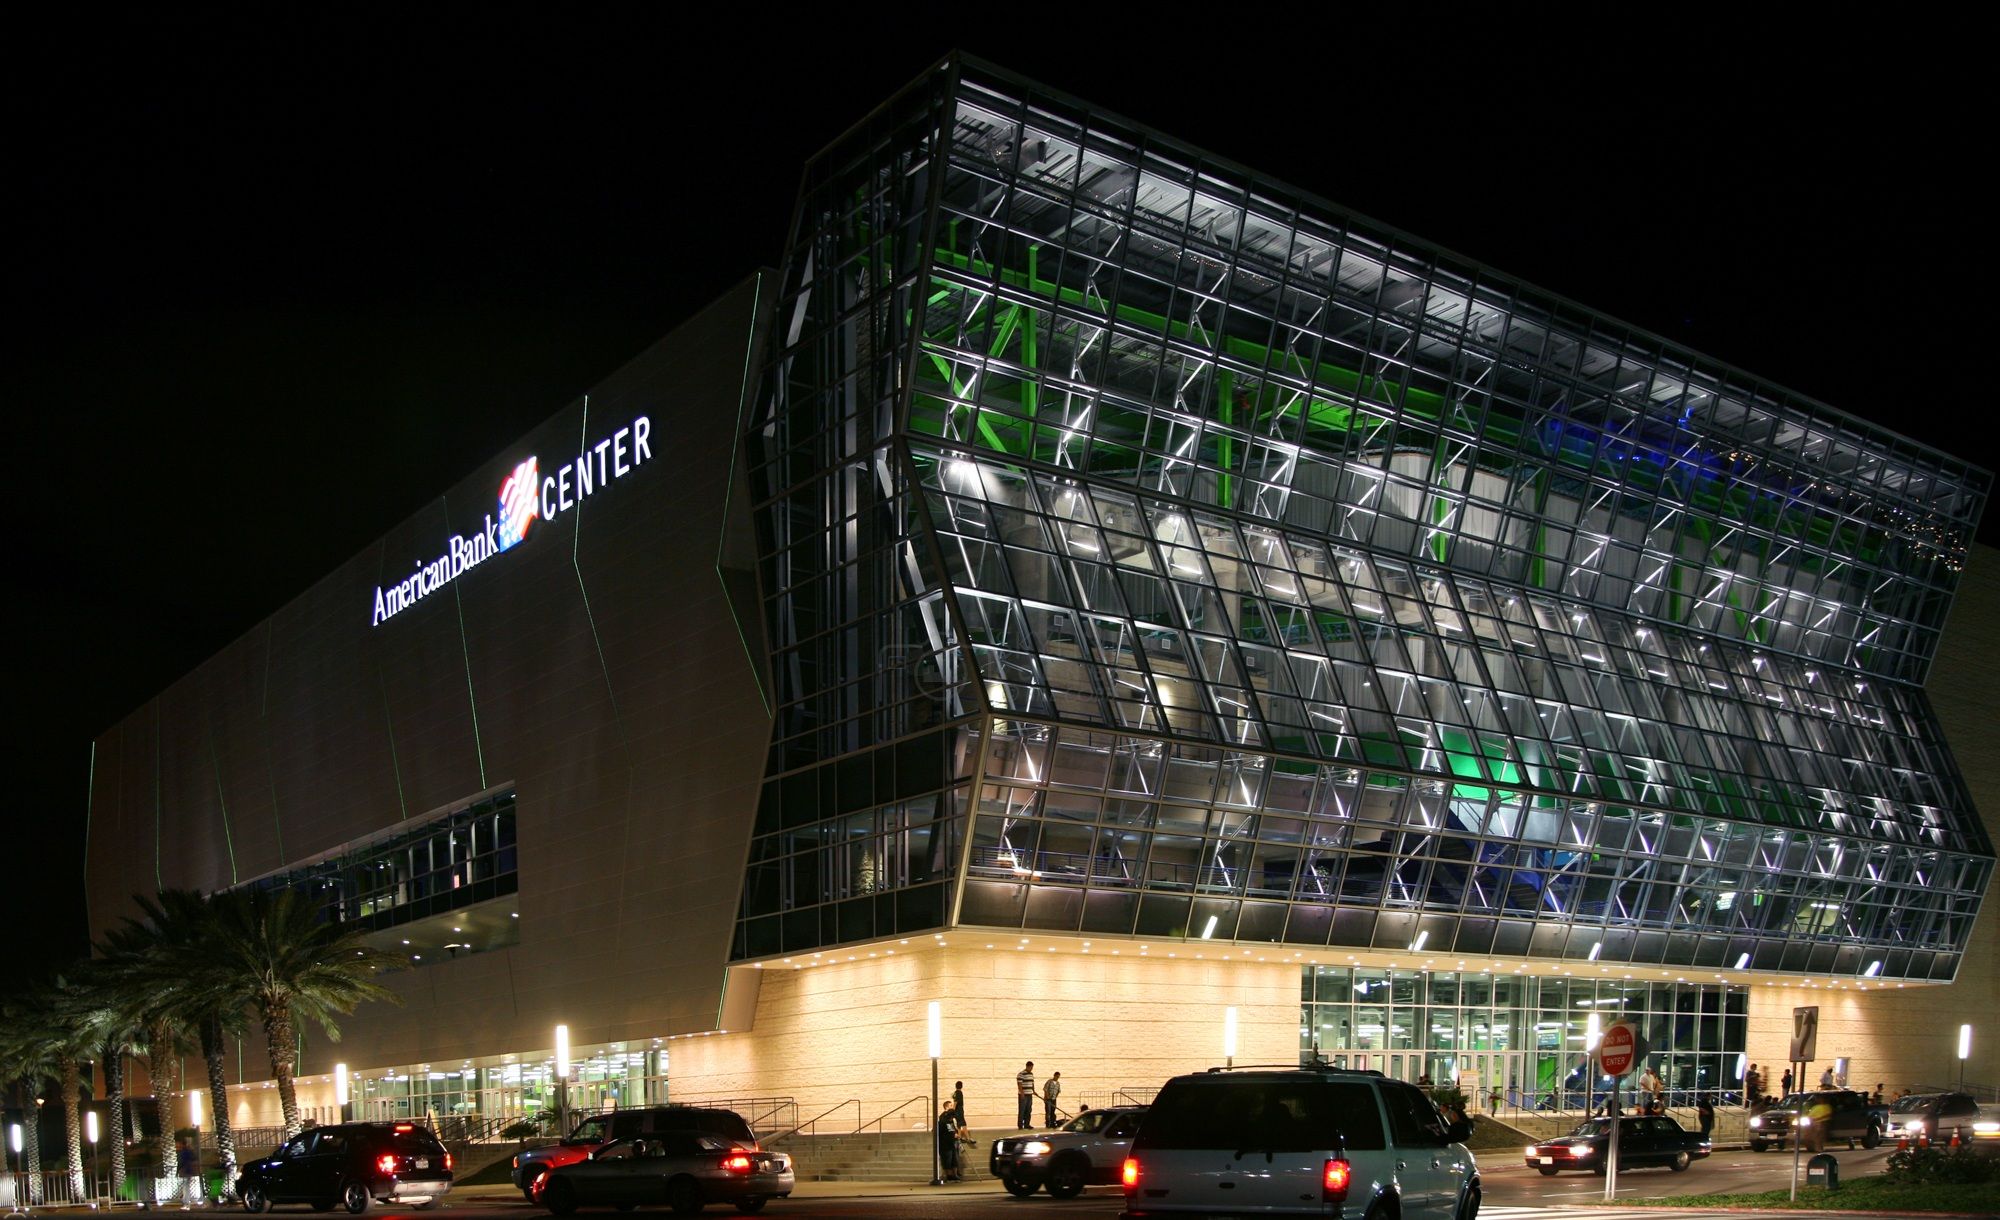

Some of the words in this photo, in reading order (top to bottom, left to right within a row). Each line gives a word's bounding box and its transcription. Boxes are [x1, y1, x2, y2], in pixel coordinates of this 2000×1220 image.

[542, 416, 652, 521] CENTER
[1605, 1035, 1615, 1045] DO
[1616, 1034, 1630, 1043] NOT
[1606, 1057, 1625, 1066] ENTER
